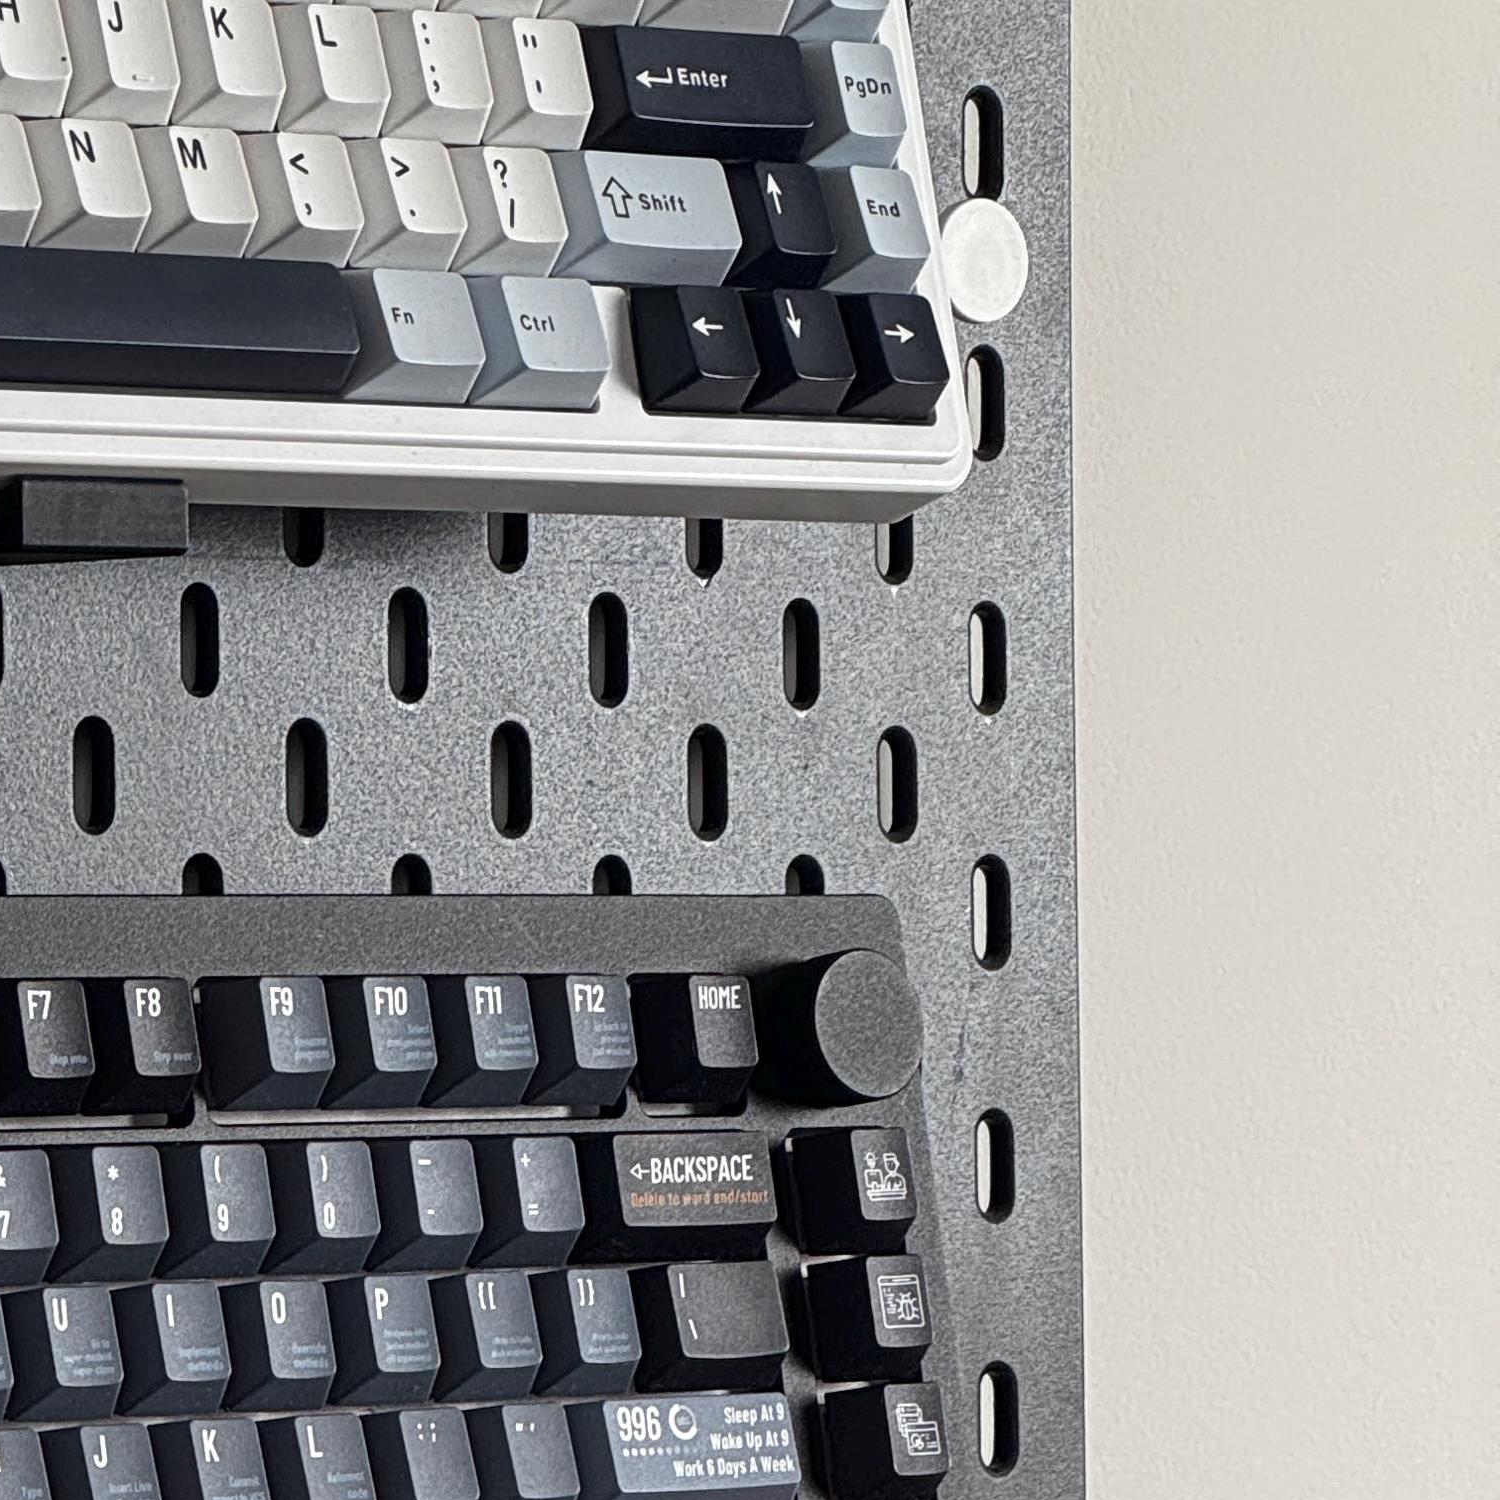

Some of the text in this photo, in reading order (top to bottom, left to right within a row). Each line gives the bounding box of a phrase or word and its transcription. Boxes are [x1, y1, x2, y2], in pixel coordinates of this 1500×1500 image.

[108, 1, 122, 32] J
[211, 7, 233, 39] K
[316, 15, 337, 47] L
[677, 68, 727, 87] Enter
[844, 76, 892, 99] PgDn
[70, 130, 95, 162] N
[177, 138, 207, 170] M
[639, 194, 686, 212] Shift
[867, 200, 900, 217] End
[392, 308, 414, 324] Fn
[520, 315, 554, 331] Ctrl
[28, 990, 51, 1019] F7
[136, 988, 161, 1017] F8
[270, 987, 293, 1016] F9
[375, 987, 407, 1015] F10
[475, 986, 502, 1014] F11
[574, 984, 605, 1012] F12
[699, 986, 740, 1009] HOME
[651, 1155, 753, 1183] BACKSPACE
[631, 1189, 768, 1208] Delete to word end/start
[112, 1207, 122, 1235] 8
[218, 1204, 228, 1231] 9
[324, 1202, 335, 1229] 0
[53, 1298, 67, 1331] U
[272, 1292, 286, 1324] O
[375, 1288, 388, 1319] P
[617, 1406, 661, 1441] 996
[724, 1403, 784, 1426] Sleep At 9
[94, 1435, 107, 1468] J
[202, 1430, 219, 1462] K
[307, 1426, 323, 1457] L
[710, 1429, 790, 1452] Wake Up At 9
[673, 1455, 795, 1478] Work 6 Days A Week
[21, 1487, 43, 1500] Type
